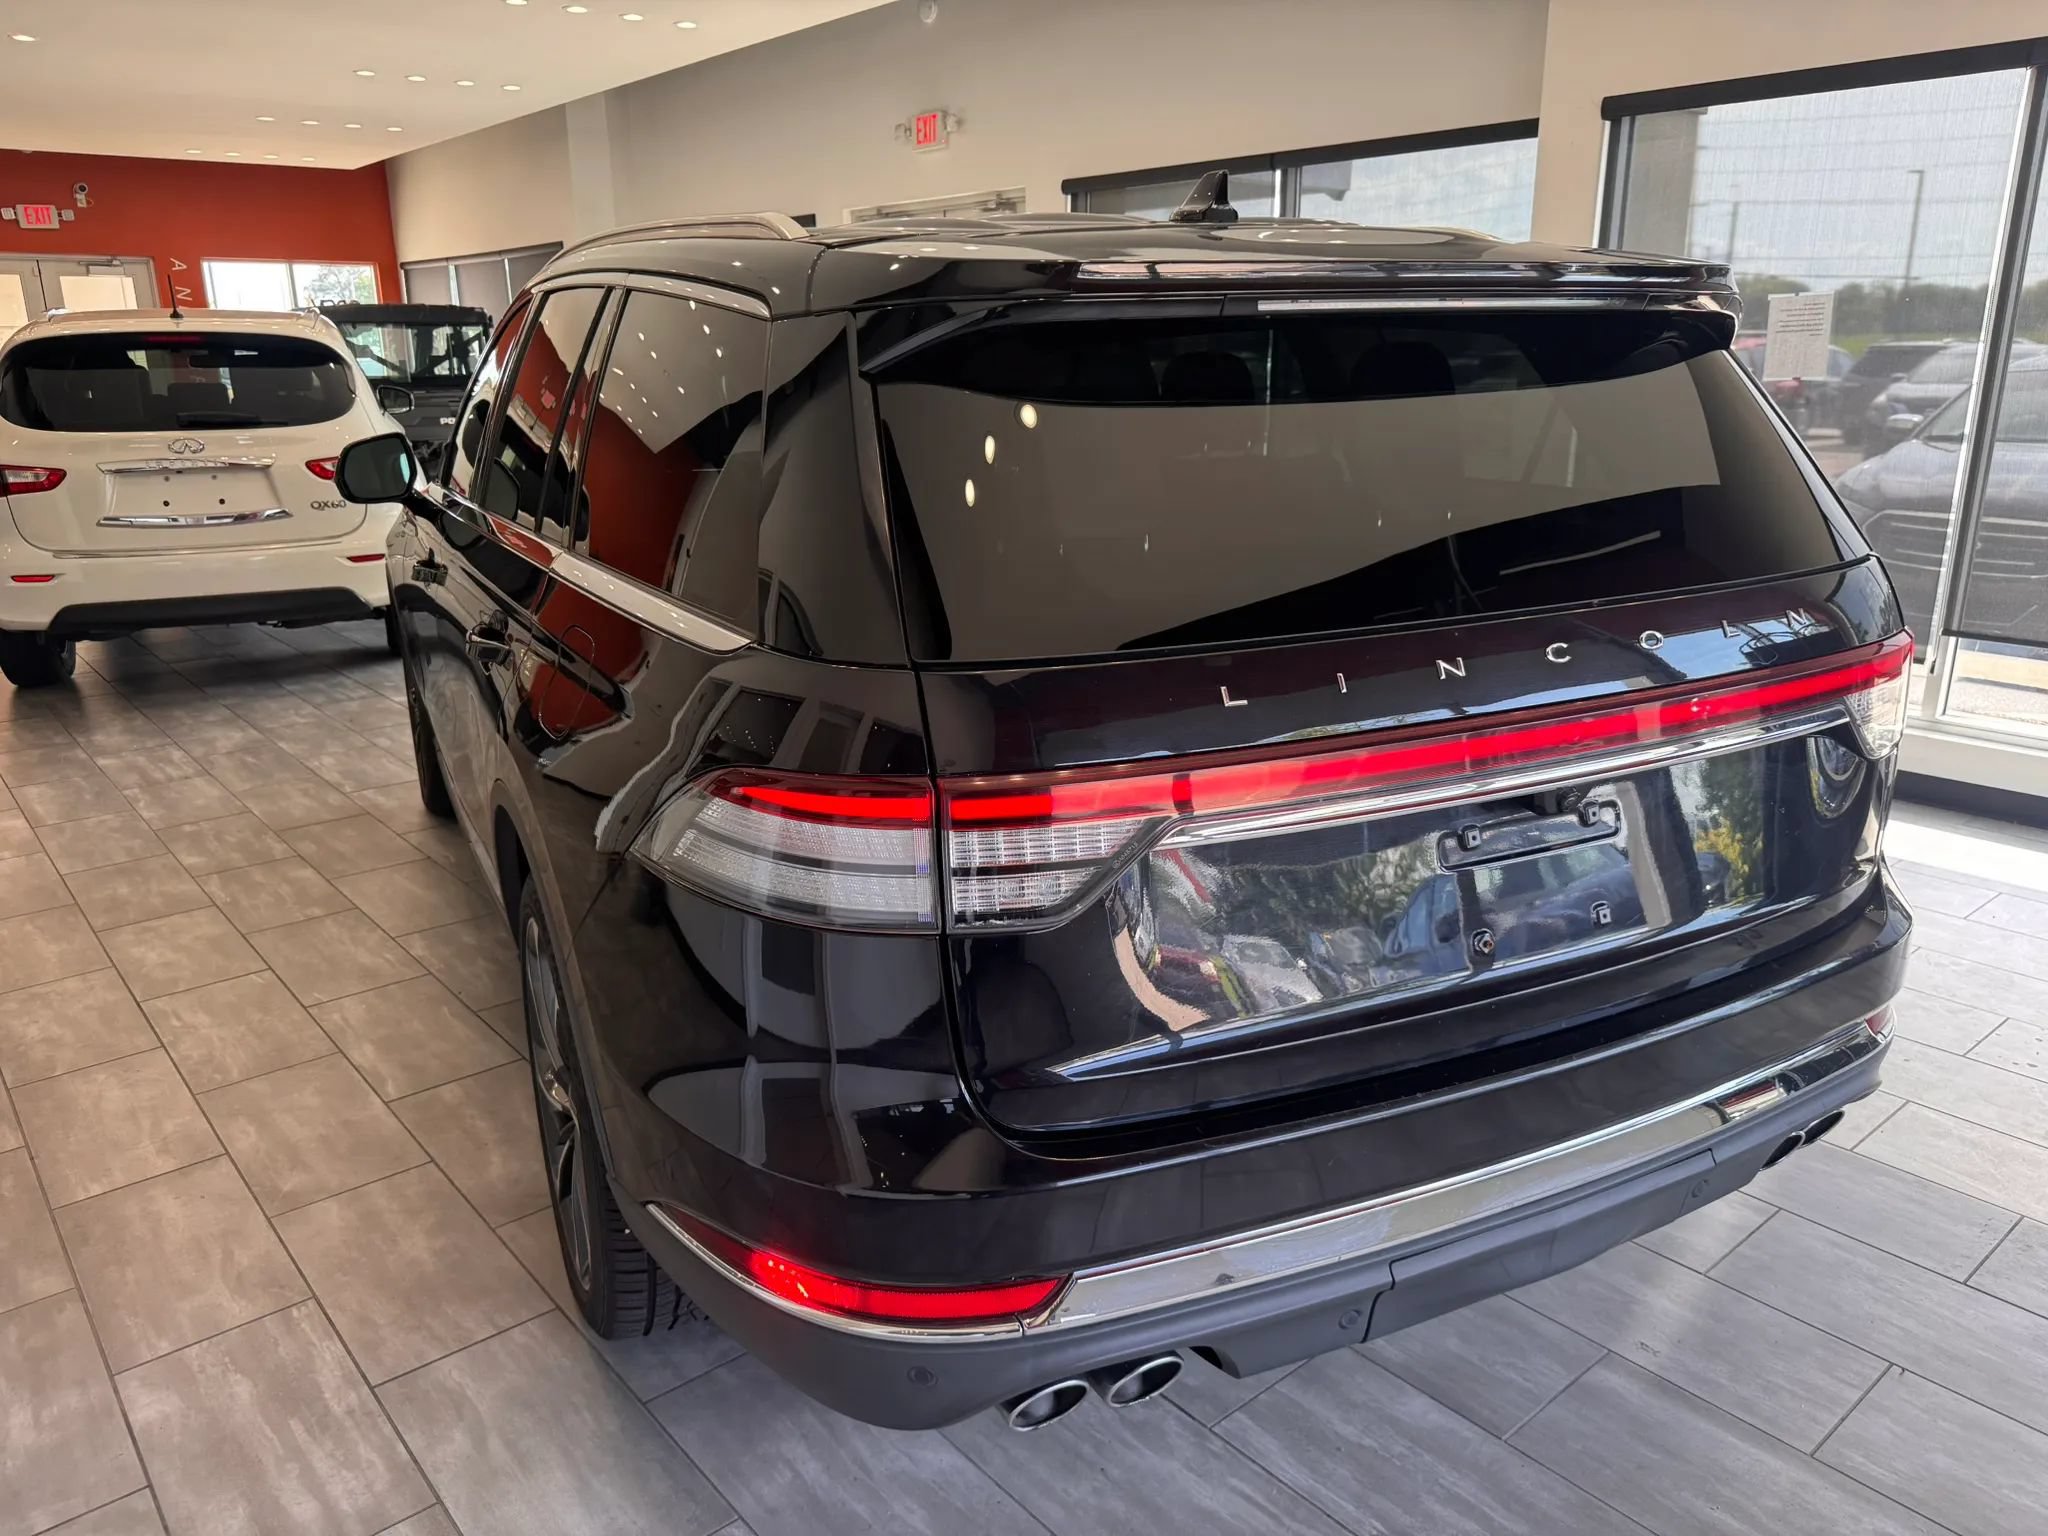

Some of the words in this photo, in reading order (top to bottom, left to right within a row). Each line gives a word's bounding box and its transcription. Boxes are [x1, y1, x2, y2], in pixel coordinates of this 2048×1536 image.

[916, 112, 939, 145] EXIT
[23, 206, 53, 225] EXIT
[310, 499, 346, 511] QX60
[1220, 607, 1815, 708] LINCOLN
